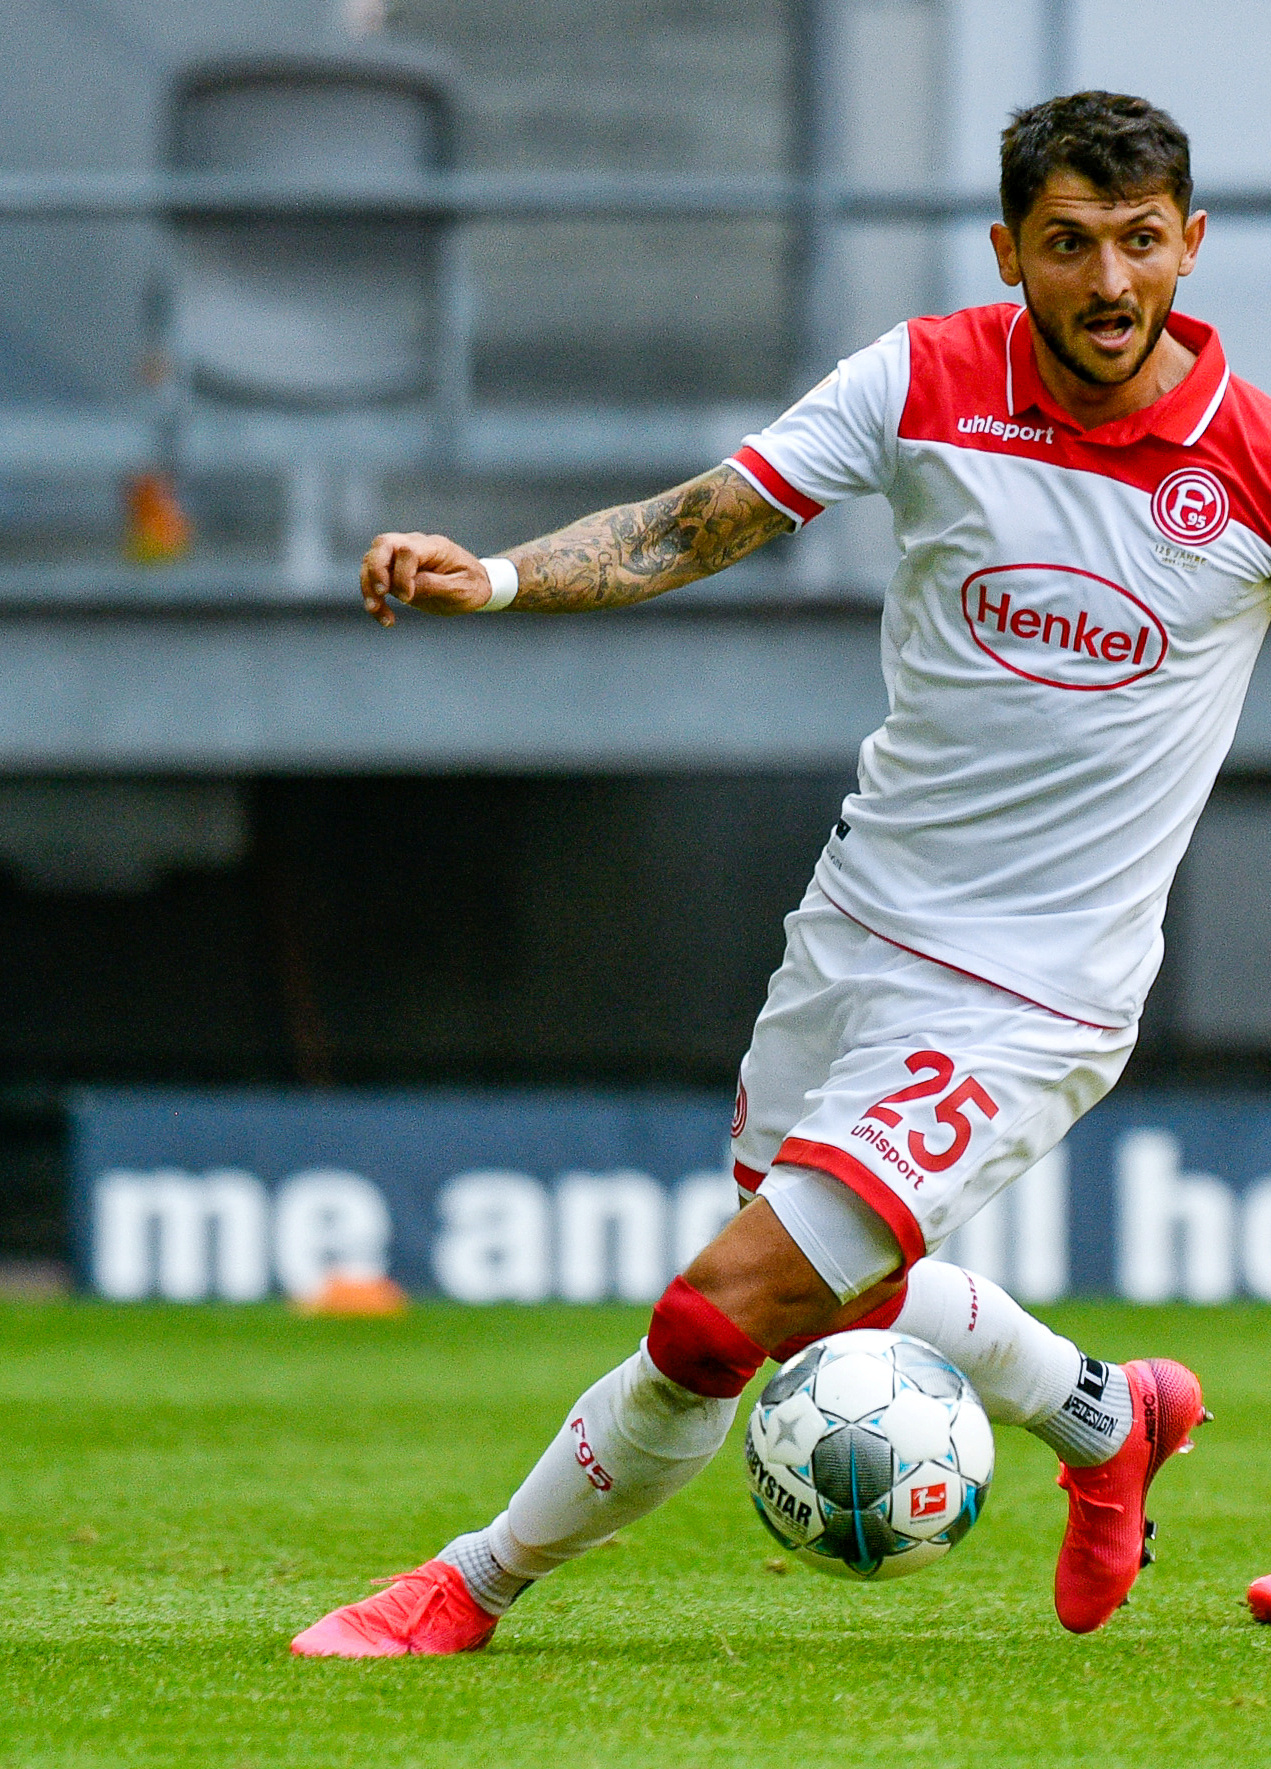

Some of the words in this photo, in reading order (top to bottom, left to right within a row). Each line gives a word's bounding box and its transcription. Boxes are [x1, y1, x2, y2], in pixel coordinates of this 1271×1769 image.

[957, 415, 1054, 445] uhlsport
[976, 584, 1150, 665] Henkel
[861, 1050, 1000, 1173] 25
[850, 1124, 926, 1192] uhlsport
[91, 1168, 393, 1304] me
[570, 1417, 614, 1492] F95
